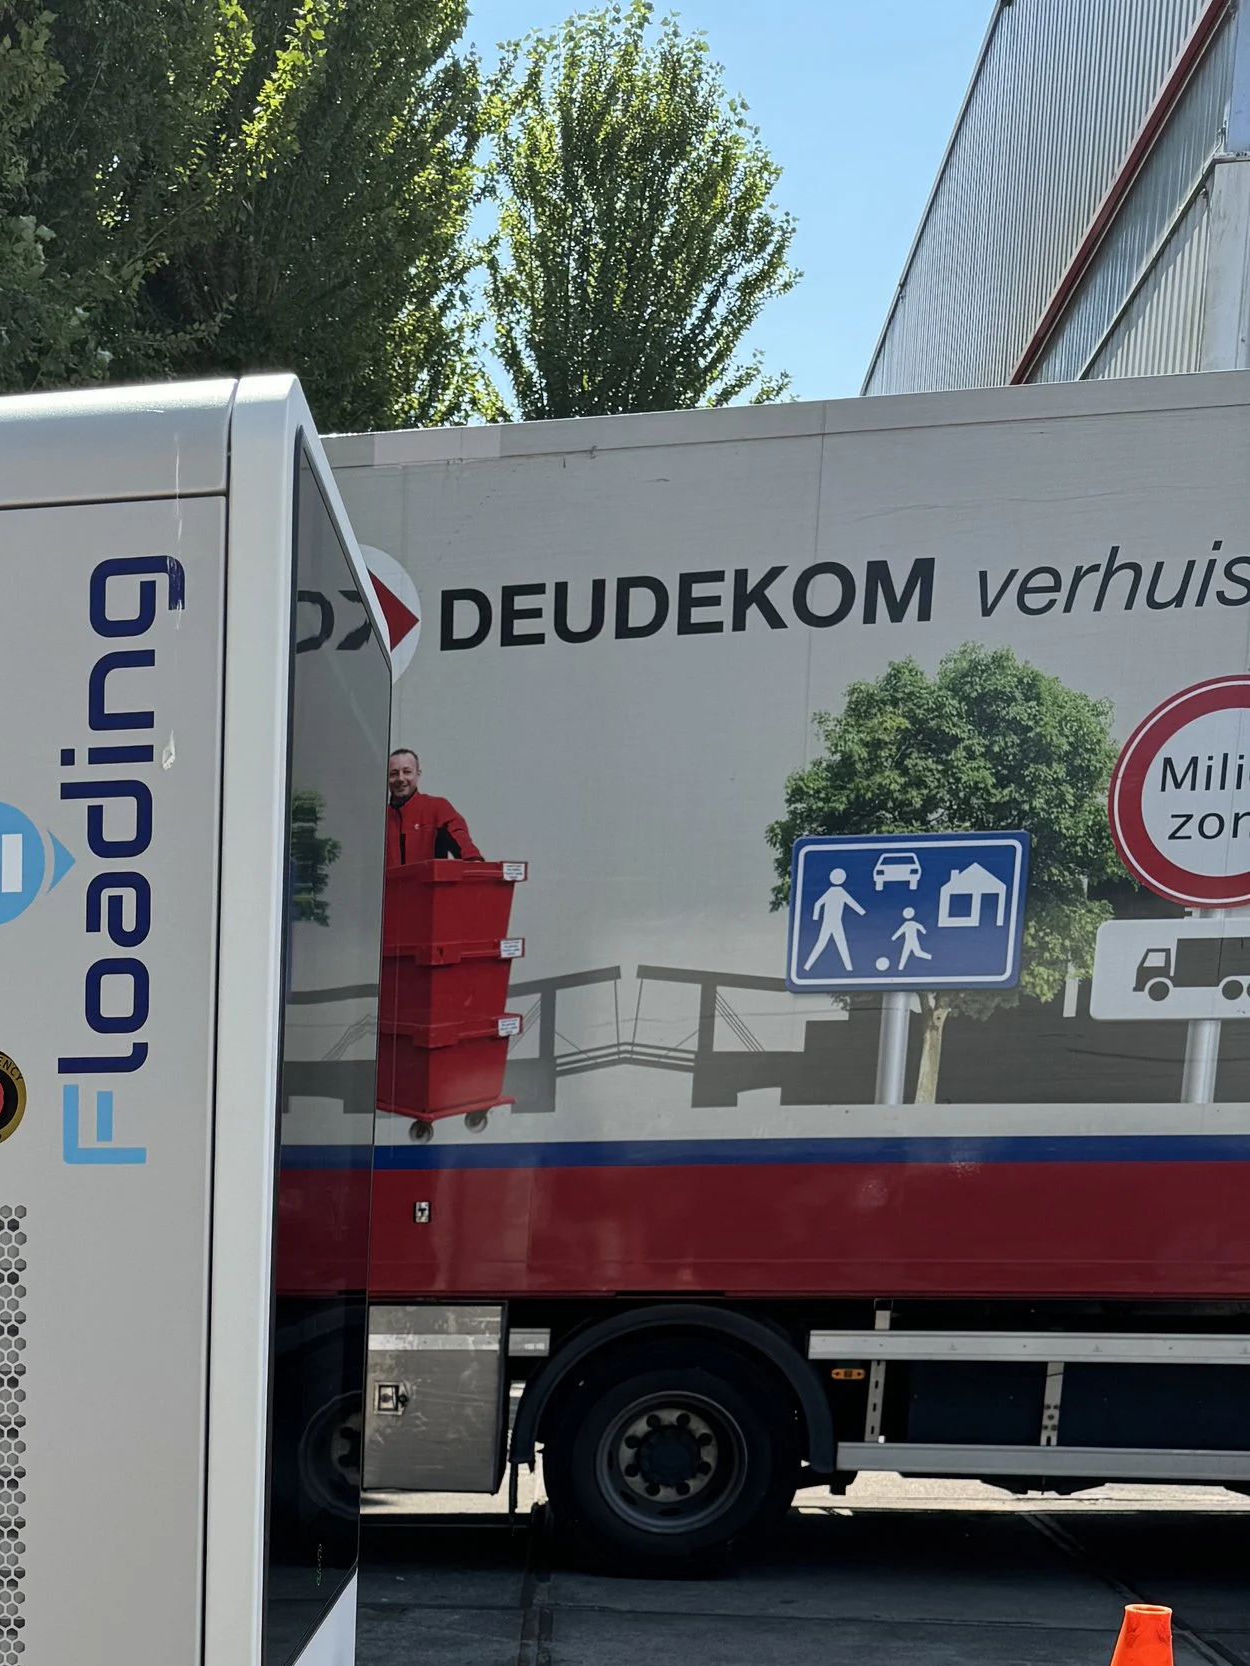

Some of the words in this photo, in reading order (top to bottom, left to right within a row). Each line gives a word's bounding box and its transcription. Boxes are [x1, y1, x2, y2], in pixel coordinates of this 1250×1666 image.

[440, 557, 936, 652] DEUDEKOM
[1160, 752, 1250, 793] Mili
[57, 555, 185, 1164] Floading
